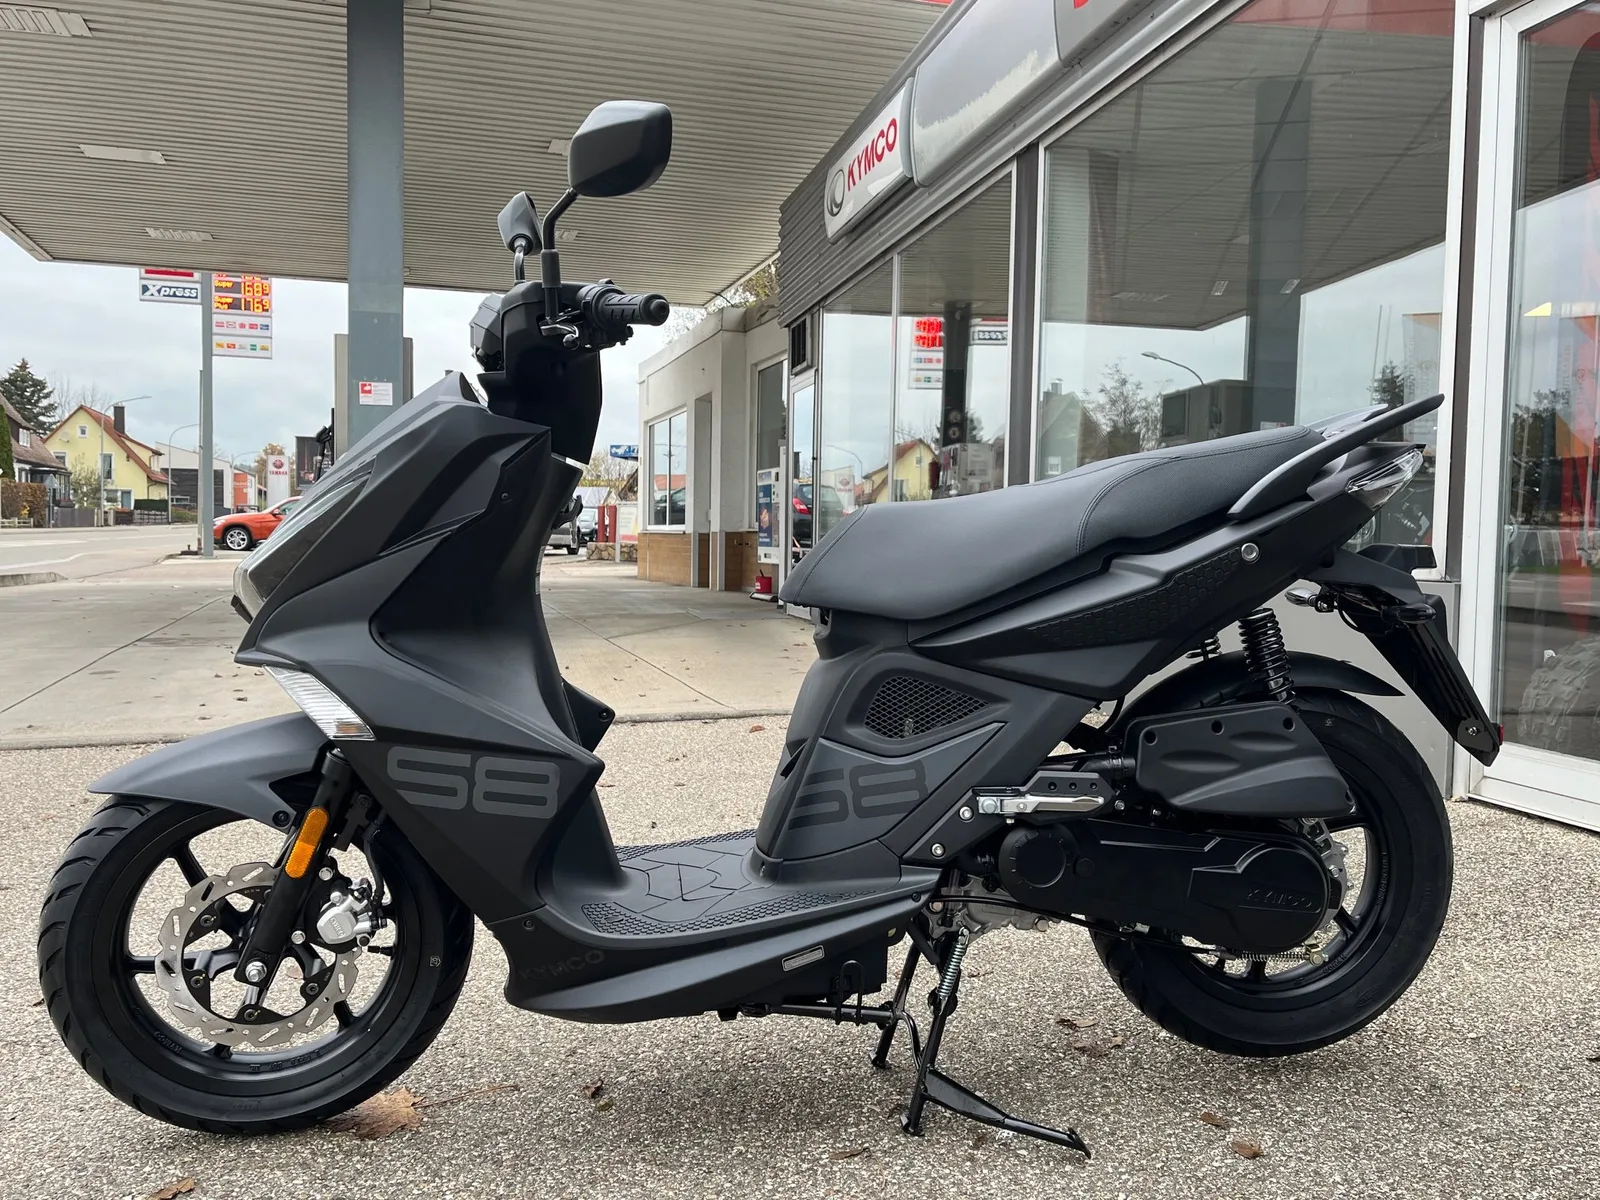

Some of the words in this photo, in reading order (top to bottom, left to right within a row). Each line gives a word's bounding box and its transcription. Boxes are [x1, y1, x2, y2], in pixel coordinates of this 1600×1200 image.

[847, 117, 898, 192] KYMCO
[143, 284, 198, 298] Xpress
[214, 279, 234, 289] Super
[387, 745, 561, 819] S8
[788, 759, 929, 831] S8
[518, 949, 606, 979] KYMCO
